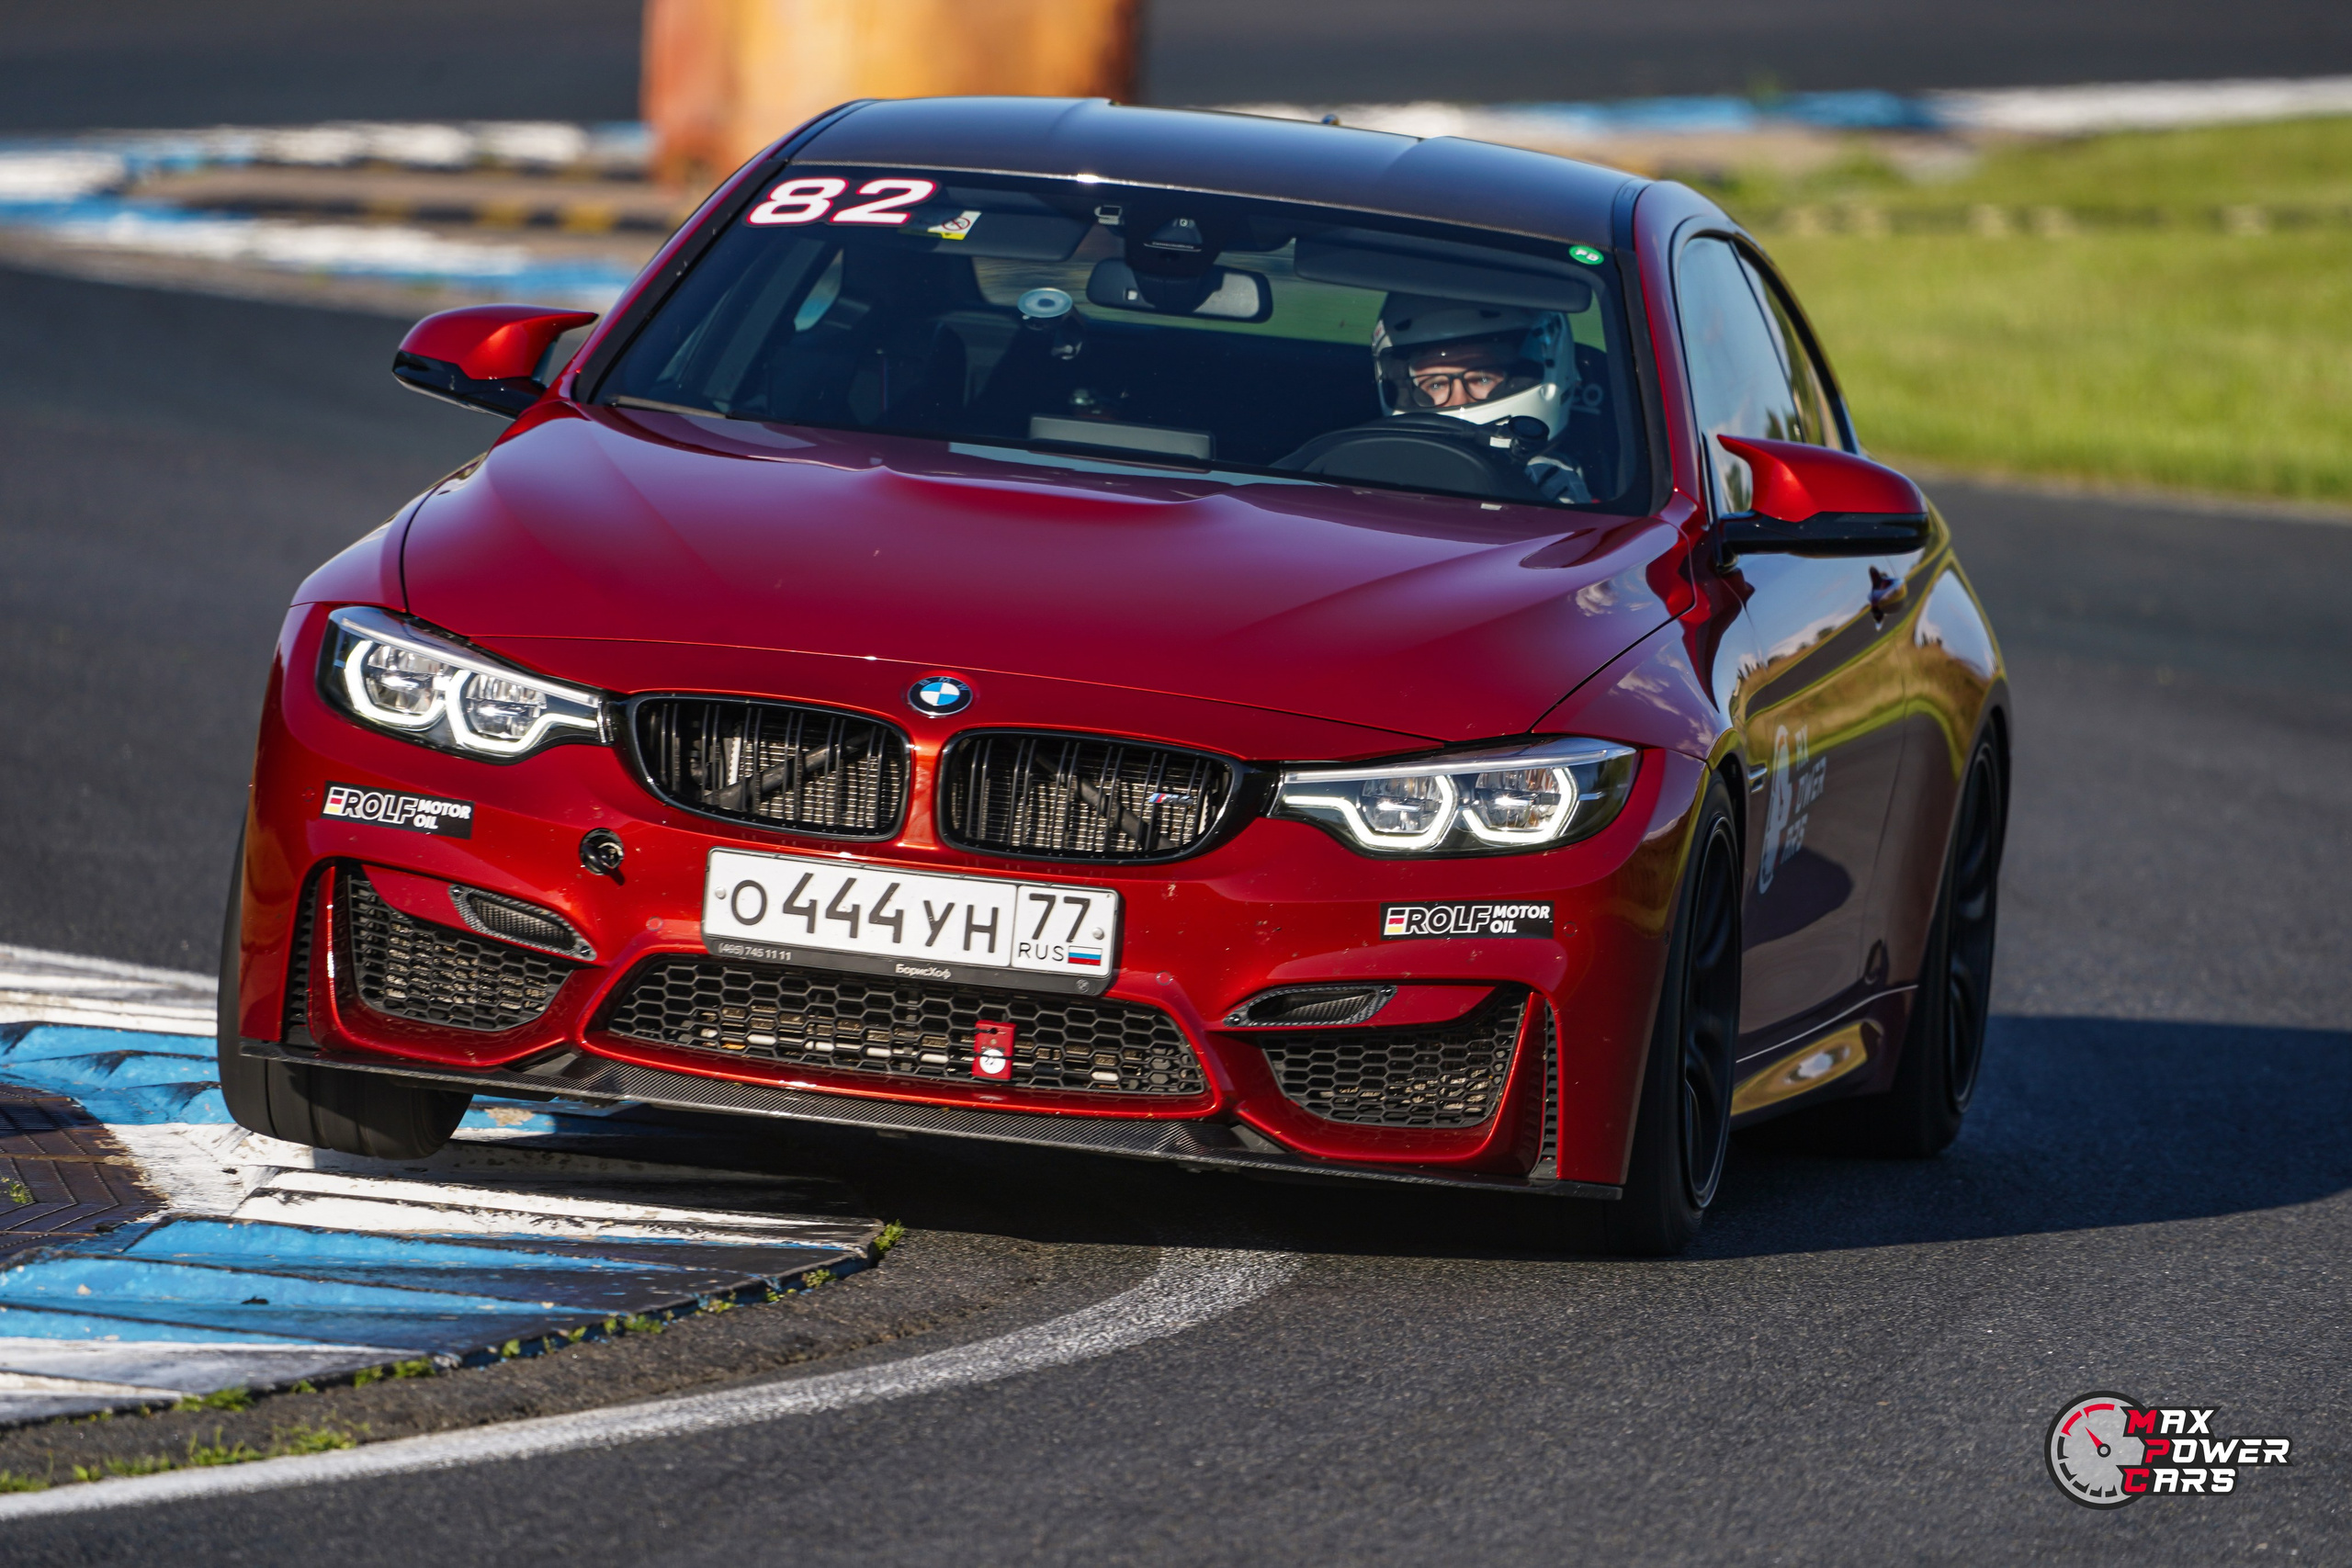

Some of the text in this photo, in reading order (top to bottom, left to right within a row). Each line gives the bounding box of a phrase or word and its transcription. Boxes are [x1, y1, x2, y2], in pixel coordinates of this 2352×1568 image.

[746, 176, 937, 225] 82
[919, 677, 969, 691] BMW
[342, 787, 472, 825] ROLF MOTOR
[413, 814, 438, 829] OIL
[1029, 893, 1091, 943] 77
[1405, 905, 1551, 935] ROLF MOTOR
[1489, 920, 1517, 934] OIL
[745, 946, 764, 958] 745
[1018, 942, 1064, 963] RUS
[895, 964, 952, 980] БорисХоф
